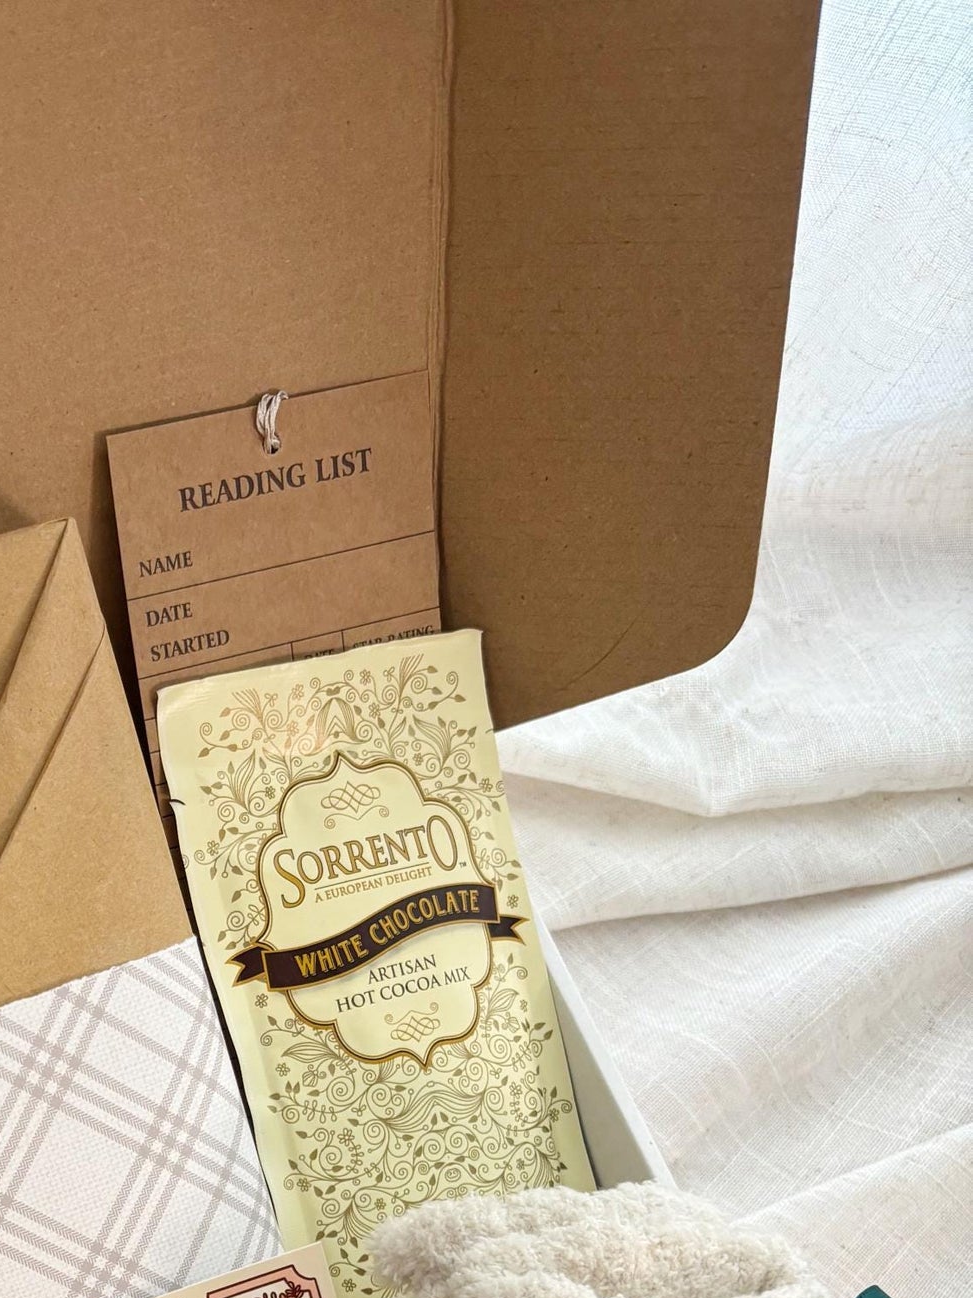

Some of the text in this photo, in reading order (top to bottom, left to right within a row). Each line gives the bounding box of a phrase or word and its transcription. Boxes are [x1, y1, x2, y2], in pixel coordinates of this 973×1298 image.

[178, 448, 372, 512] READING LIST
[138, 551, 193, 578] NAME
[145, 602, 193, 627] DATE
[150, 629, 230, 662] STARTED
[273, 815, 458, 909] SORRENTO
[314, 866, 432, 903] A EUROPEAN DELIGHT
[294, 889, 480, 978] WHITE CHOCOLATE
[367, 954, 437, 985] ARTISAN
[335, 966, 471, 1013] HOT COCOA MIX
